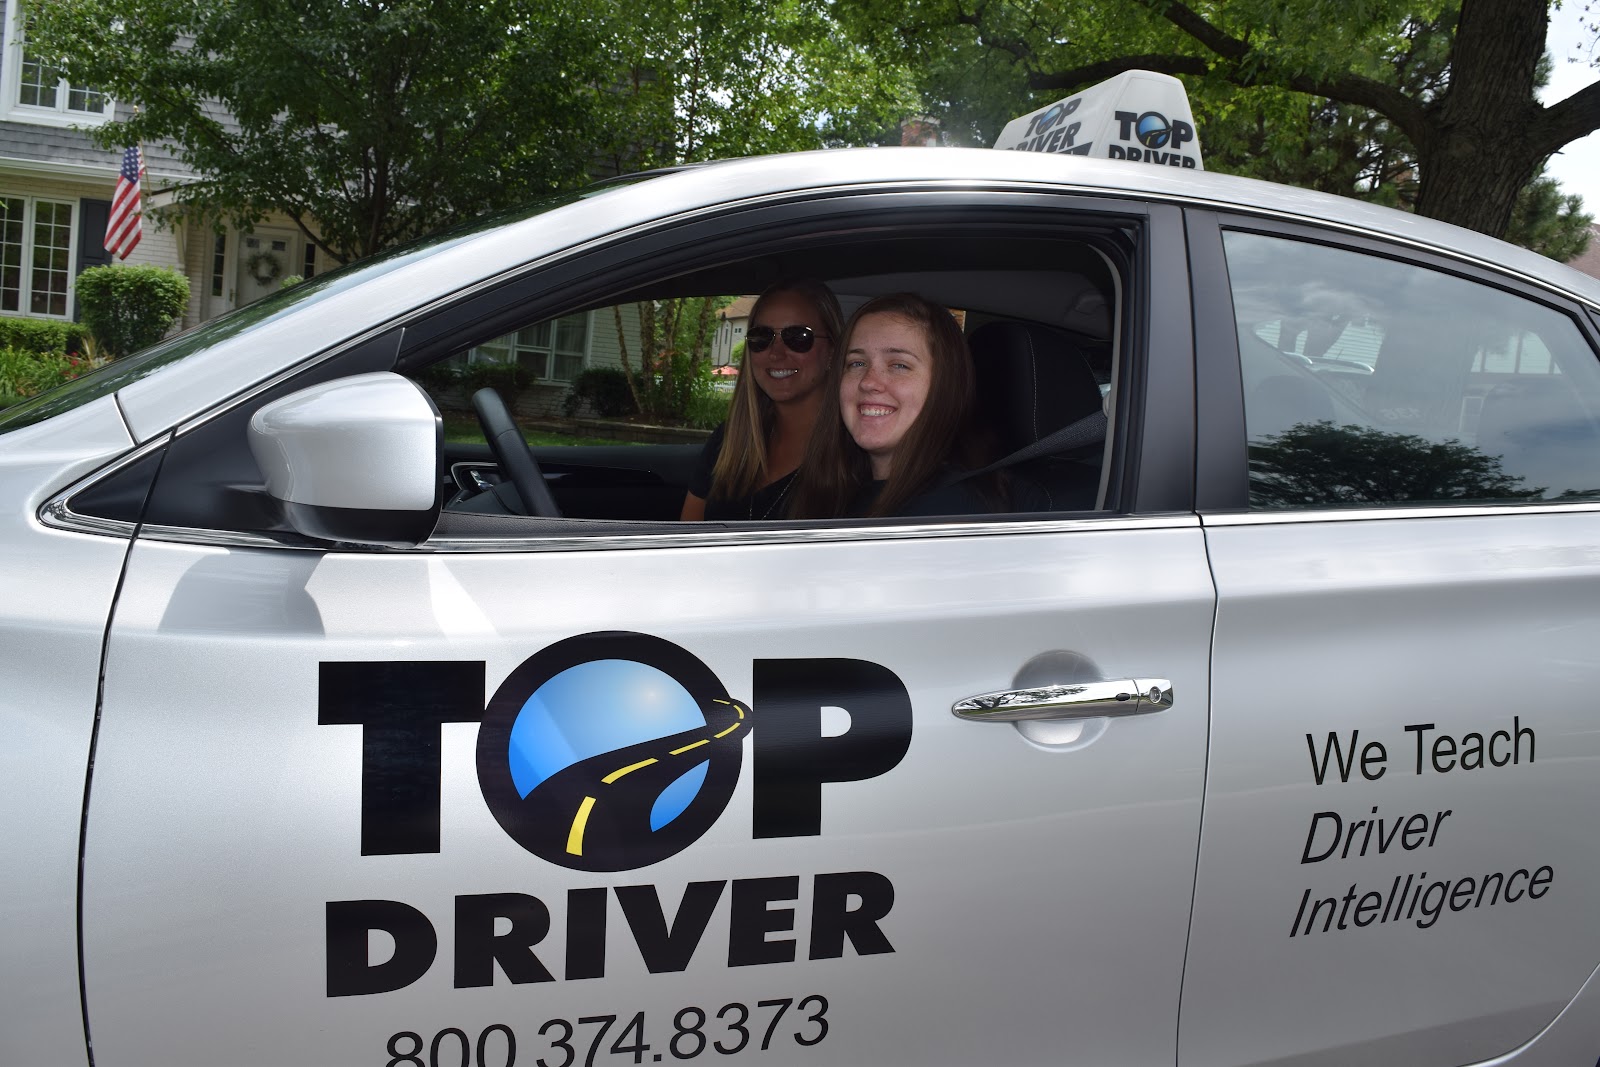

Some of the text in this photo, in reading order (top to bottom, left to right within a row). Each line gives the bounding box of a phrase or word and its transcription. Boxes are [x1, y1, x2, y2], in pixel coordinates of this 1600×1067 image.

[1024, 97, 1082, 138] TOP
[1115, 111, 1194, 150] TOP
[318, 631, 912, 872] TOP
[1306, 716, 1536, 786] We Teach
[1301, 806, 1452, 865] Driver
[325, 871, 897, 999] DRIVER
[1289, 864, 1554, 938] Intelligence
